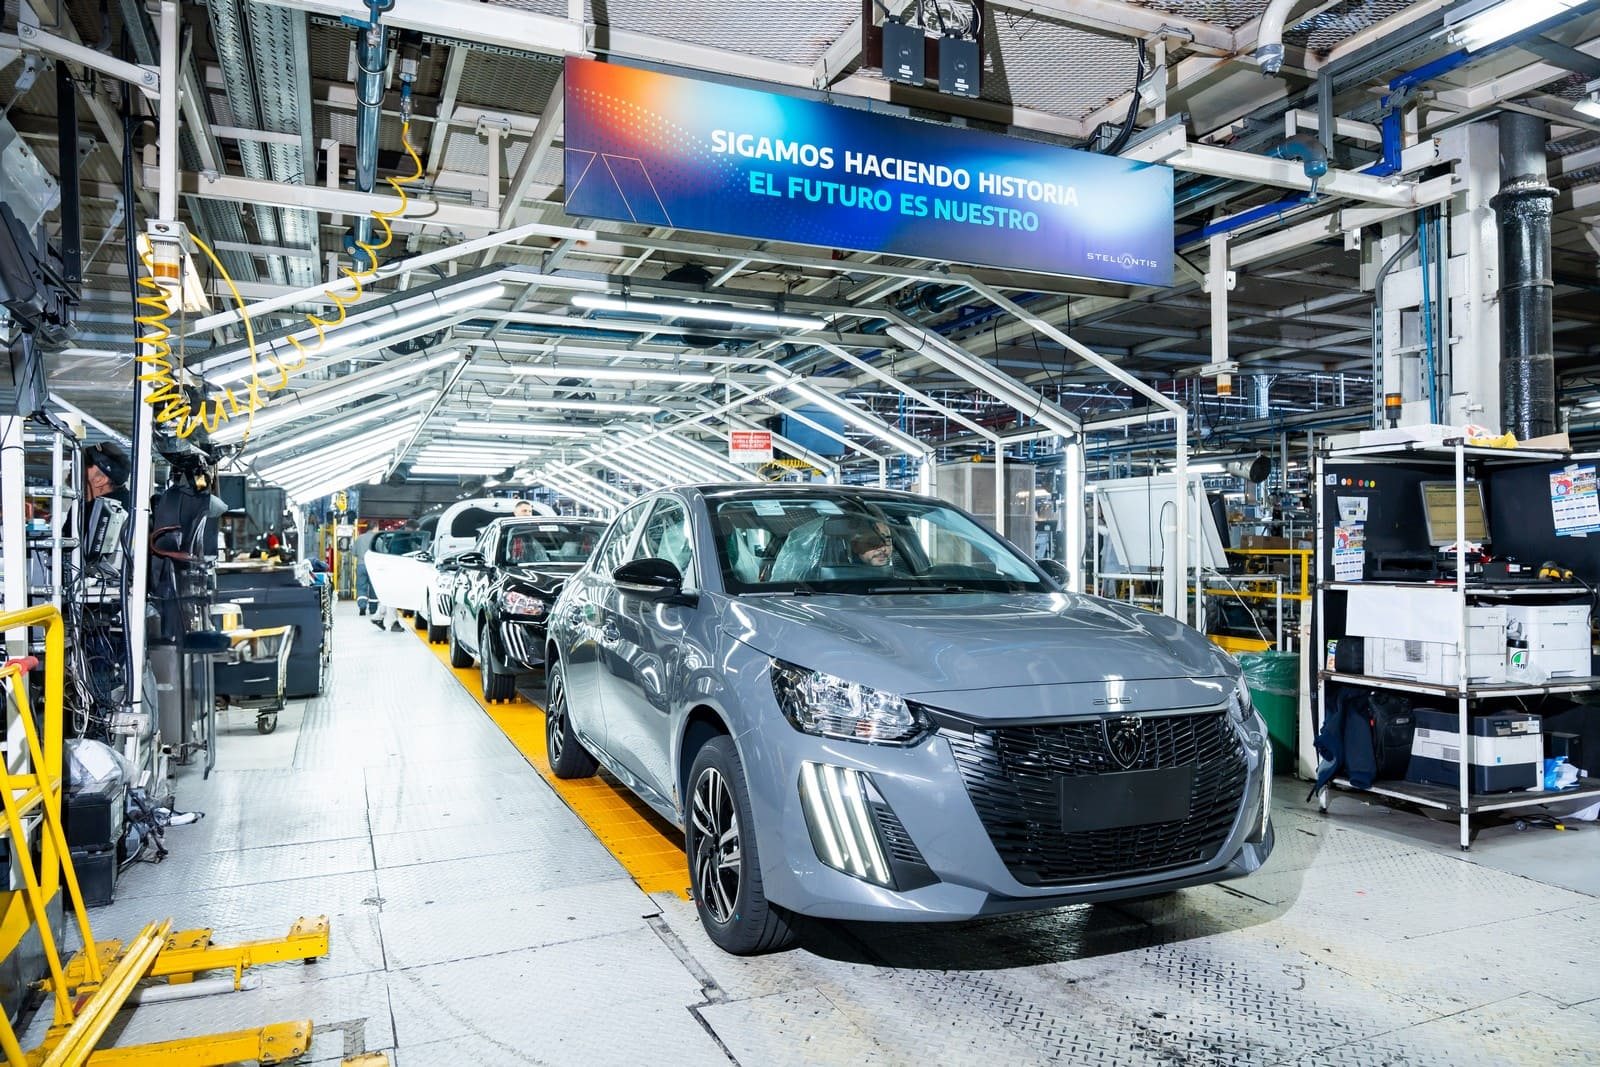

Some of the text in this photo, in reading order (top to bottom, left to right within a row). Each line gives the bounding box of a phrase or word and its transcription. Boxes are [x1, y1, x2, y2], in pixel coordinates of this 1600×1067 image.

[711, 129, 1079, 207] SIGAMOS HACIENDO HISTORIA
[749, 170, 1039, 232] EL FUTURO ES NUESTRO
[1087, 252, 1157, 268] STELLANTIS
